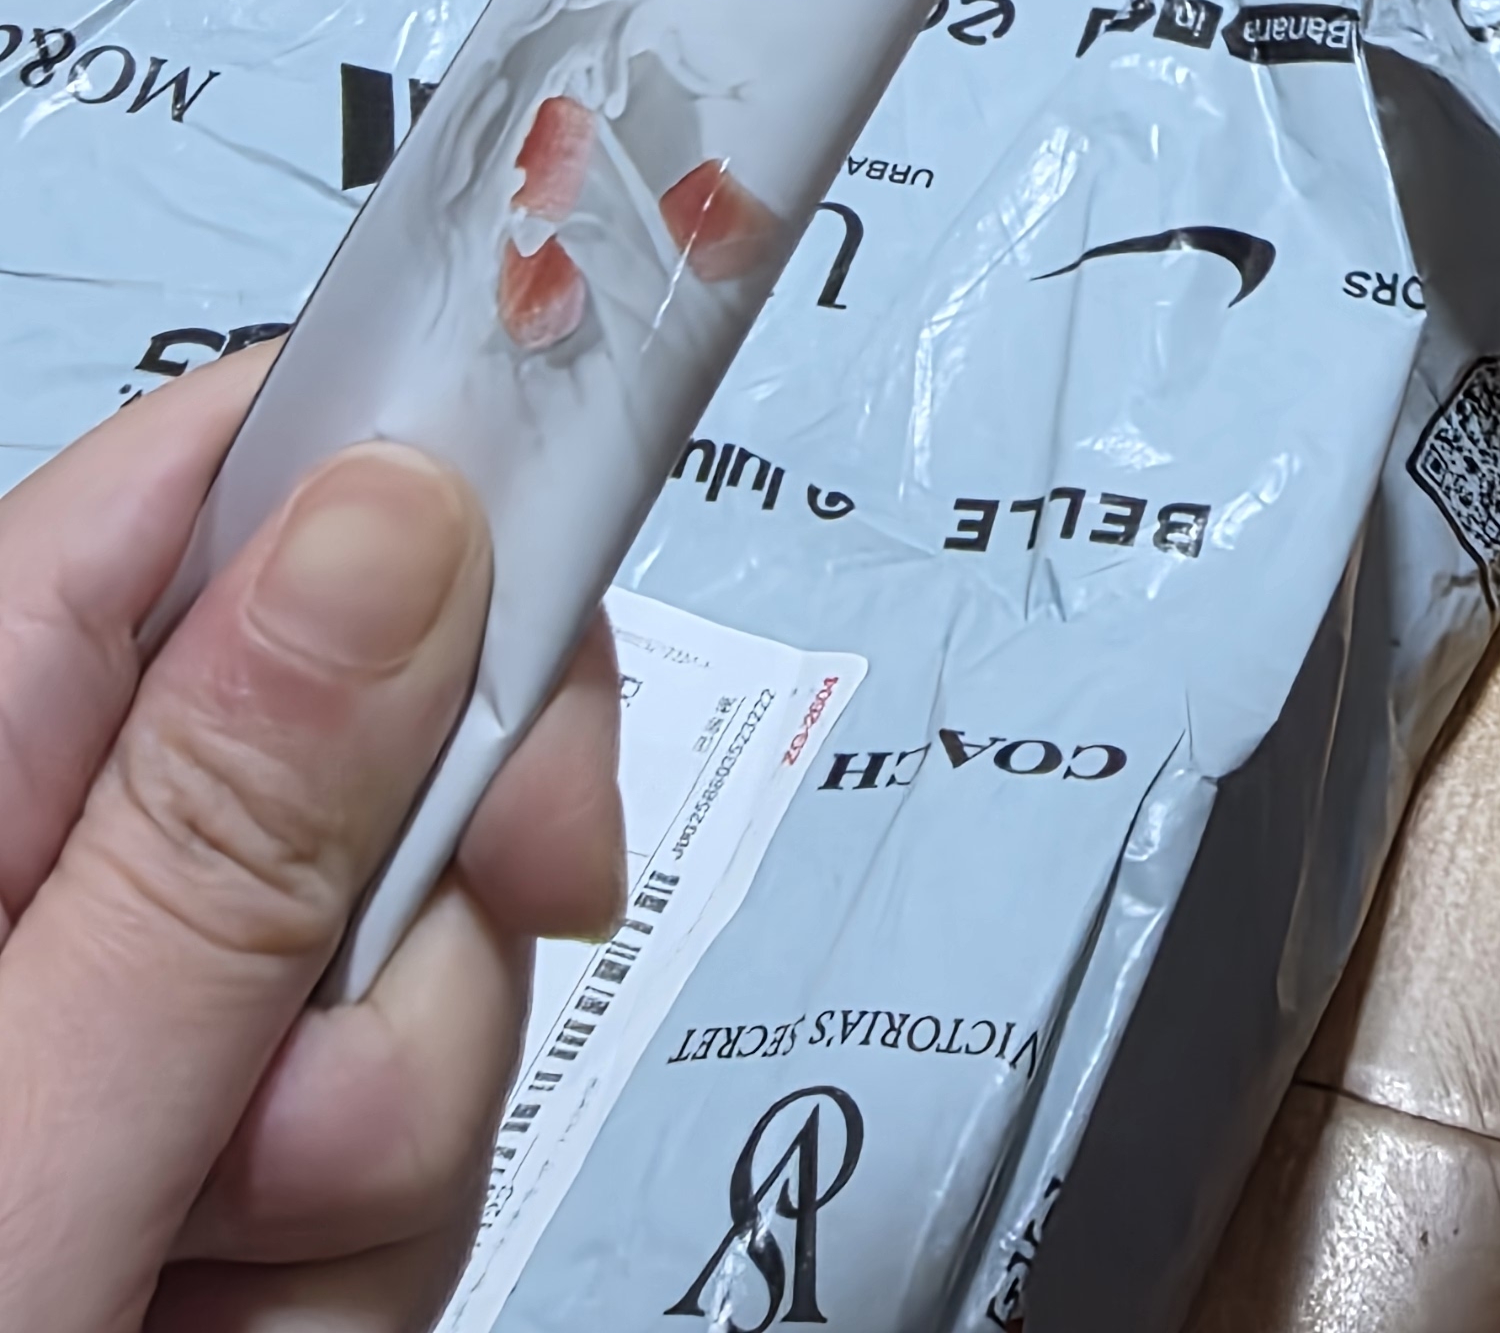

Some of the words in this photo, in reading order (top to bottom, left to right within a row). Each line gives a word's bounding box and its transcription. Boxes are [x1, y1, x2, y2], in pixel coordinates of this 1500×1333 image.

[943, 486, 1212, 559] BELLE
[816, 727, 1128, 791] COACH
[808, 1008, 1041, 1080] VICTORIA'S
